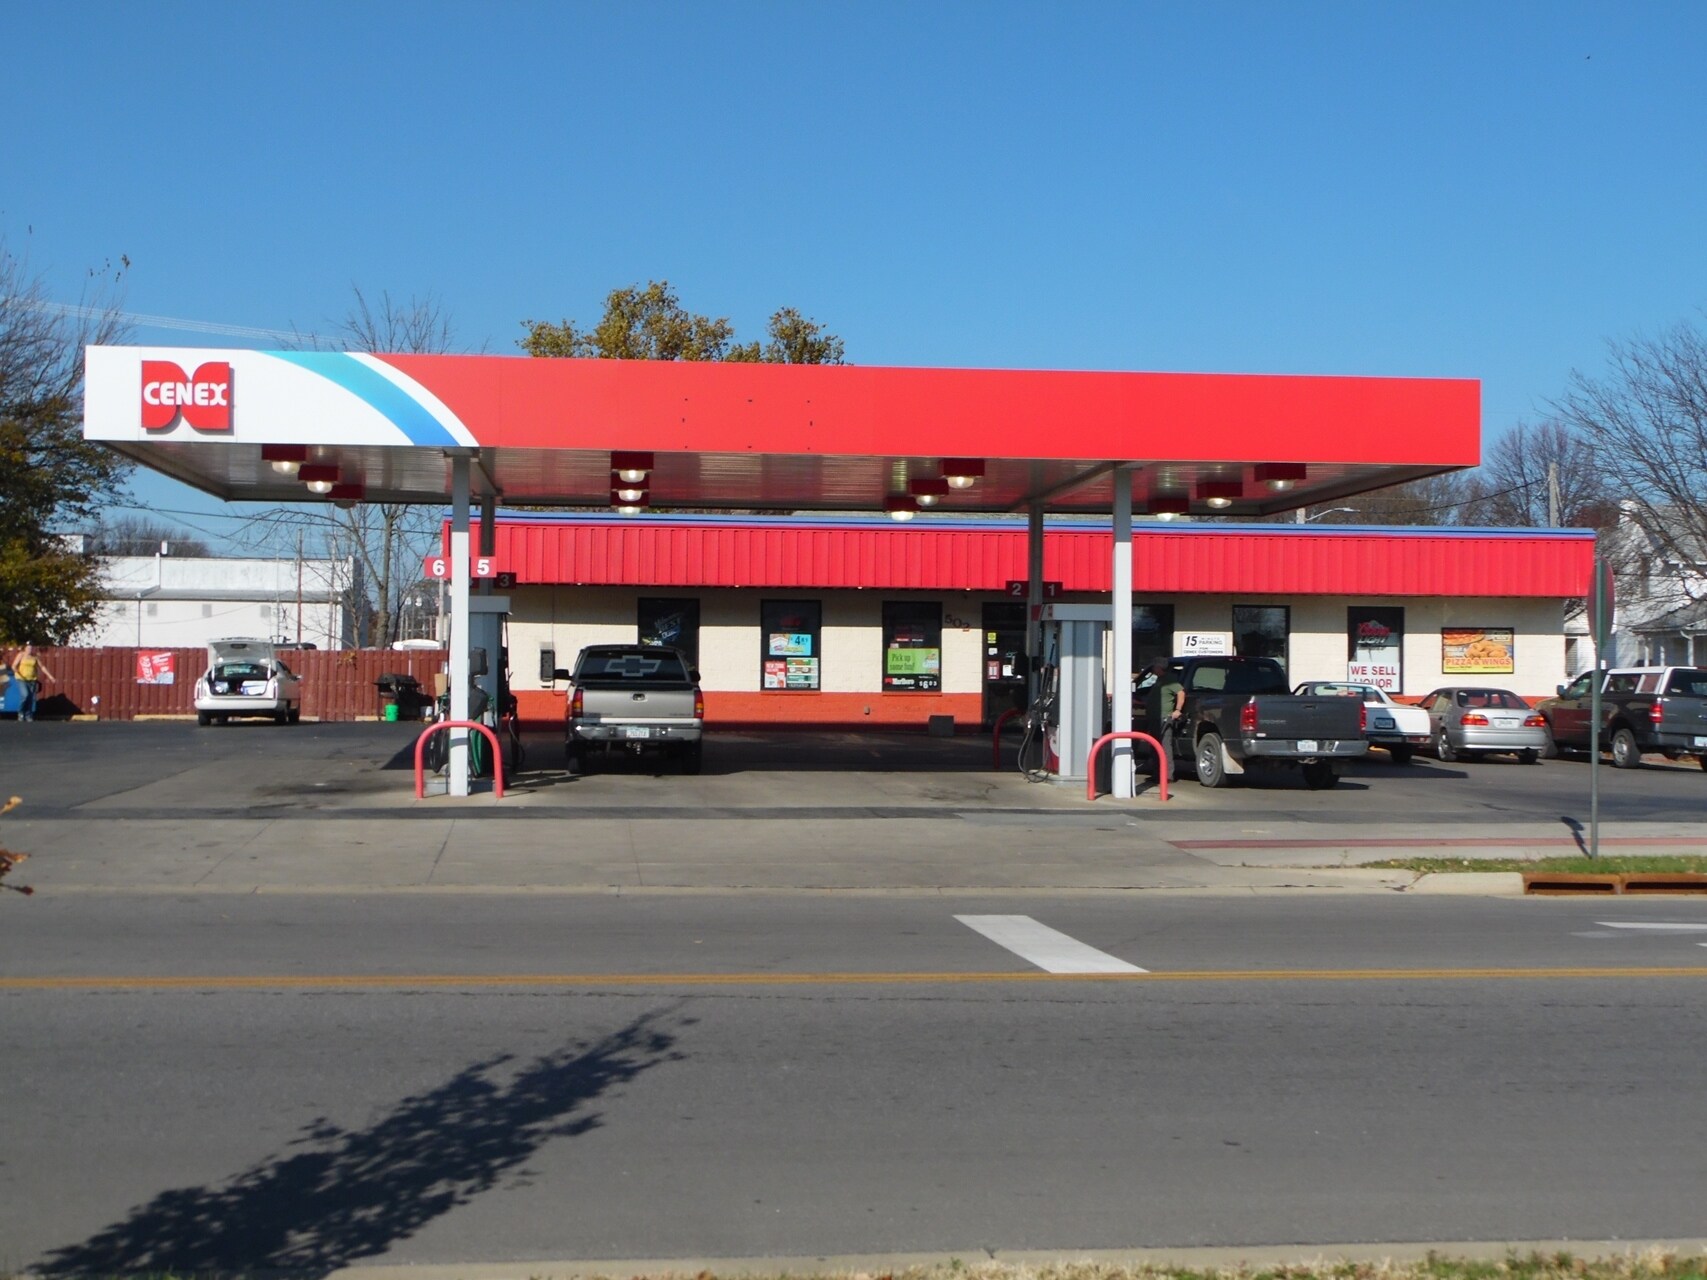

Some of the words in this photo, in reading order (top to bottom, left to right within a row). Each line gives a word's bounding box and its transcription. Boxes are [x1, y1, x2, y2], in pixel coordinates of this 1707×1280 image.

[143, 381, 228, 407] CENEX
[432, 559, 446, 577] 6
[476, 559, 490, 576] 5
[499, 574, 510, 588] 3
[1011, 582, 1022, 596] 2
[1048, 583, 1056, 597] 1
[945, 614, 971, 633] 502
[1185, 635, 1199, 647] 15
[1446, 658, 1472, 666] PIZZA
[1474, 658, 1481, 666] &
[1482, 658, 1511, 666] WINGS
[1350, 666, 1368, 676] WE
[1371, 666, 1397, 676] SELL
[1353, 679, 1392, 688] UOR
